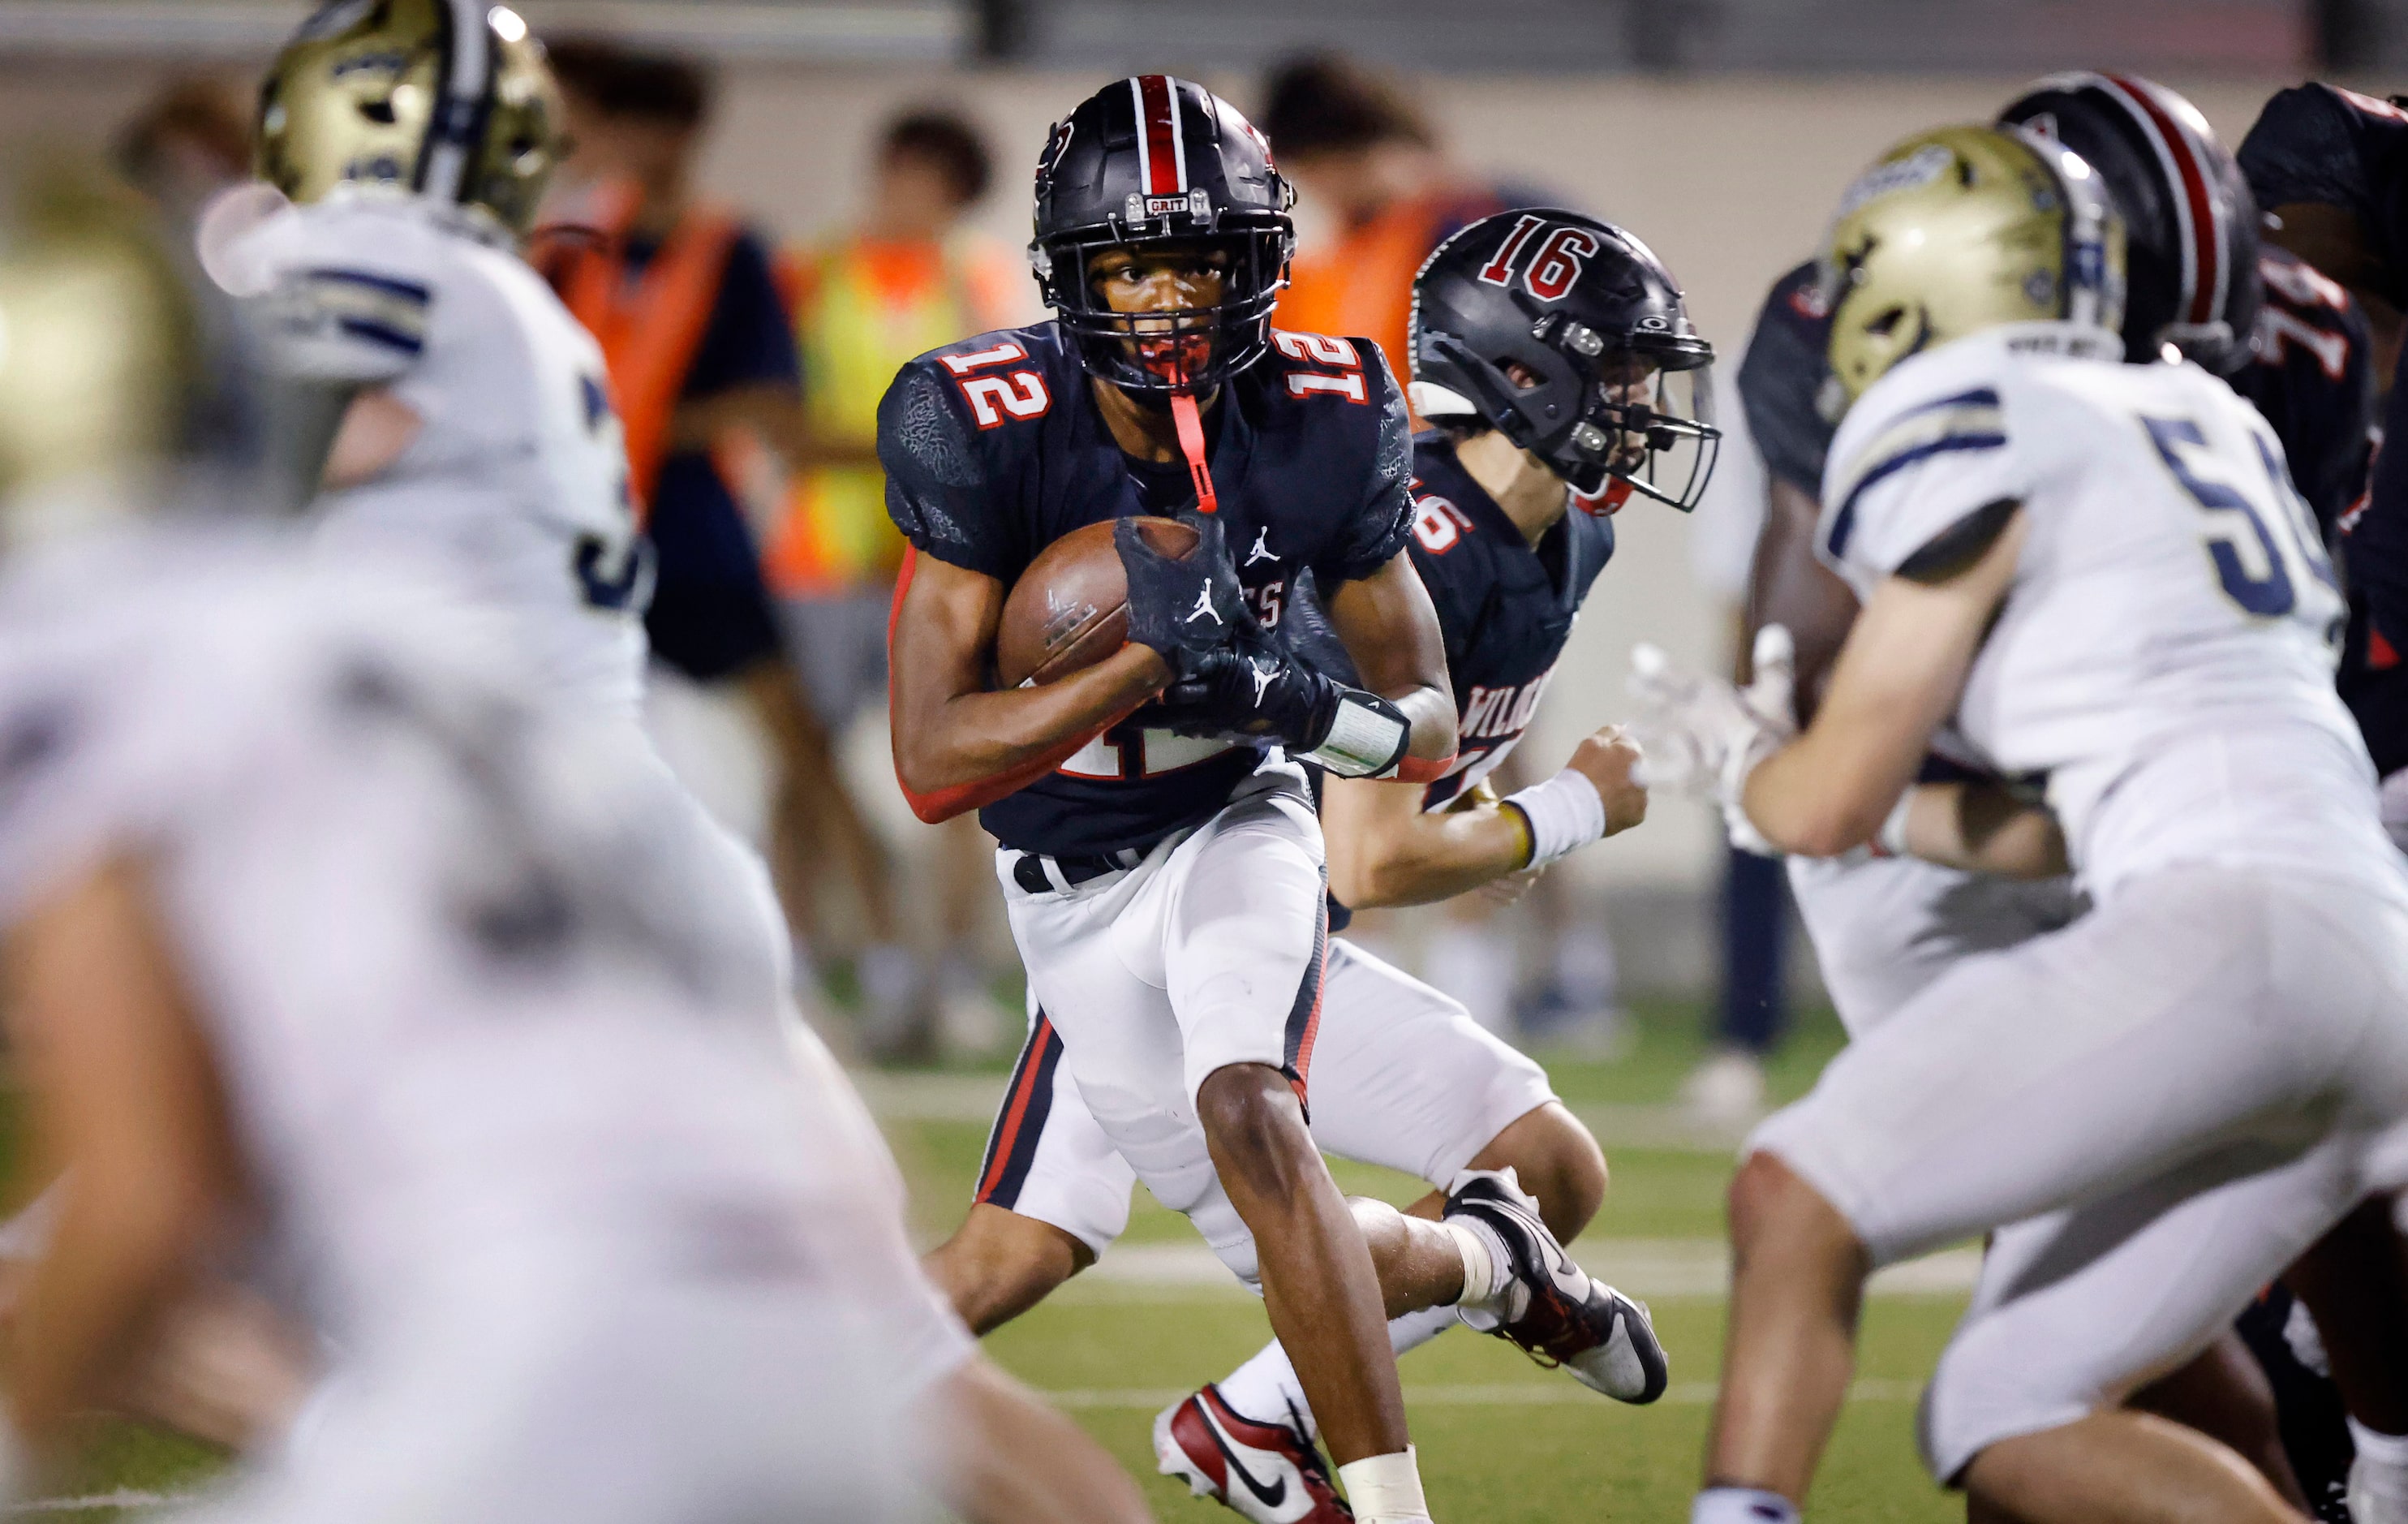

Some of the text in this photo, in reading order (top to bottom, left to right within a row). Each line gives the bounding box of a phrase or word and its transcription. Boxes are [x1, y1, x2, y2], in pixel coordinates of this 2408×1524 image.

[1152, 200, 1183, 211] GRIT
[1478, 214, 1599, 302] 16
[940, 343, 1051, 432] 12
[1271, 331, 1370, 406] 12
